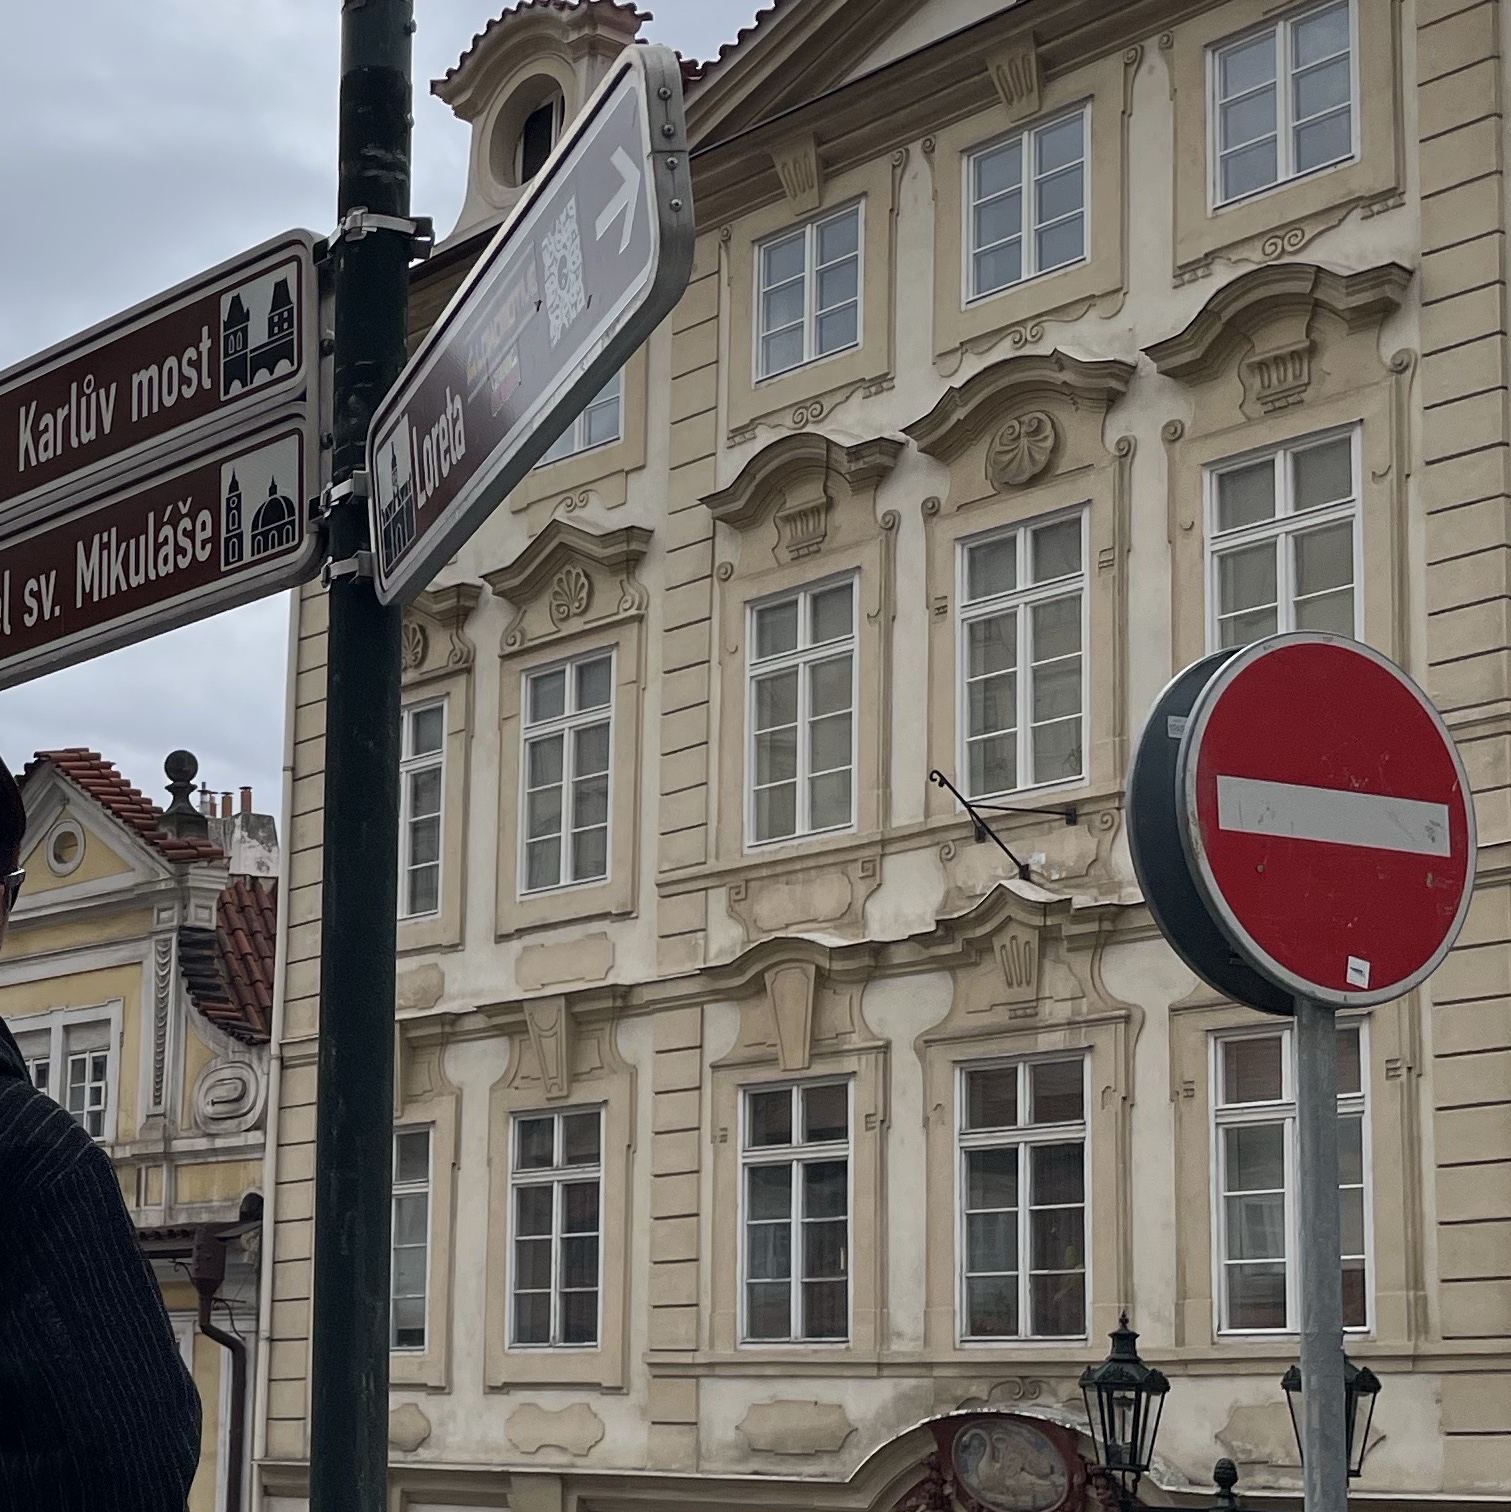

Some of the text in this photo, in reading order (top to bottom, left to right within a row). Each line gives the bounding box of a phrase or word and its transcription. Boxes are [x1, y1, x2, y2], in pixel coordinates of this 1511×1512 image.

[17, 325, 212, 472] Karlův most
[412, 386, 466, 510] Loreta
[23, 570, 62, 628] sv.
[75, 497, 213, 608] Mikuláše
